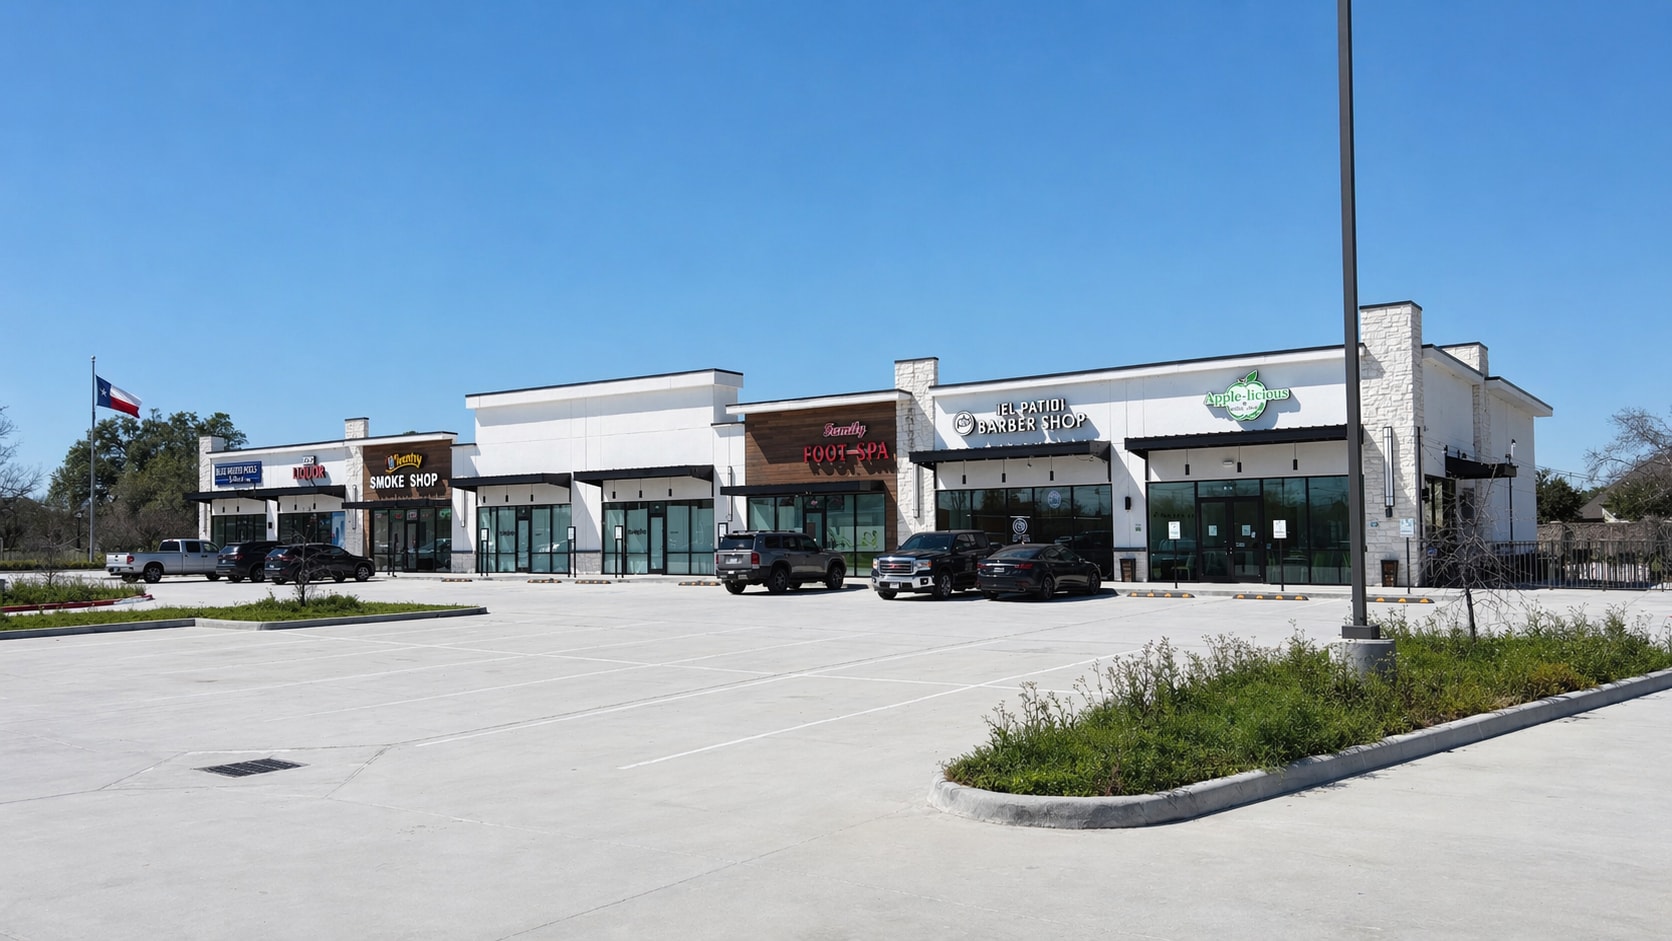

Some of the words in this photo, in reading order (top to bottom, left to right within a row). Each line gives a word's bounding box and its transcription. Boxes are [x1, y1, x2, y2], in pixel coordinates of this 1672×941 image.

[1205, 388, 1289, 407] Apple-licious
[823, 421, 867, 438] Family
[978, 418, 1036, 434] BARBER
[1042, 413, 1086, 430] SHOP
[803, 444, 847, 464] FOOT
[856, 441, 889, 461] SPA
[369, 475, 405, 489] SMOKE
[410, 473, 438, 487] SHOP
